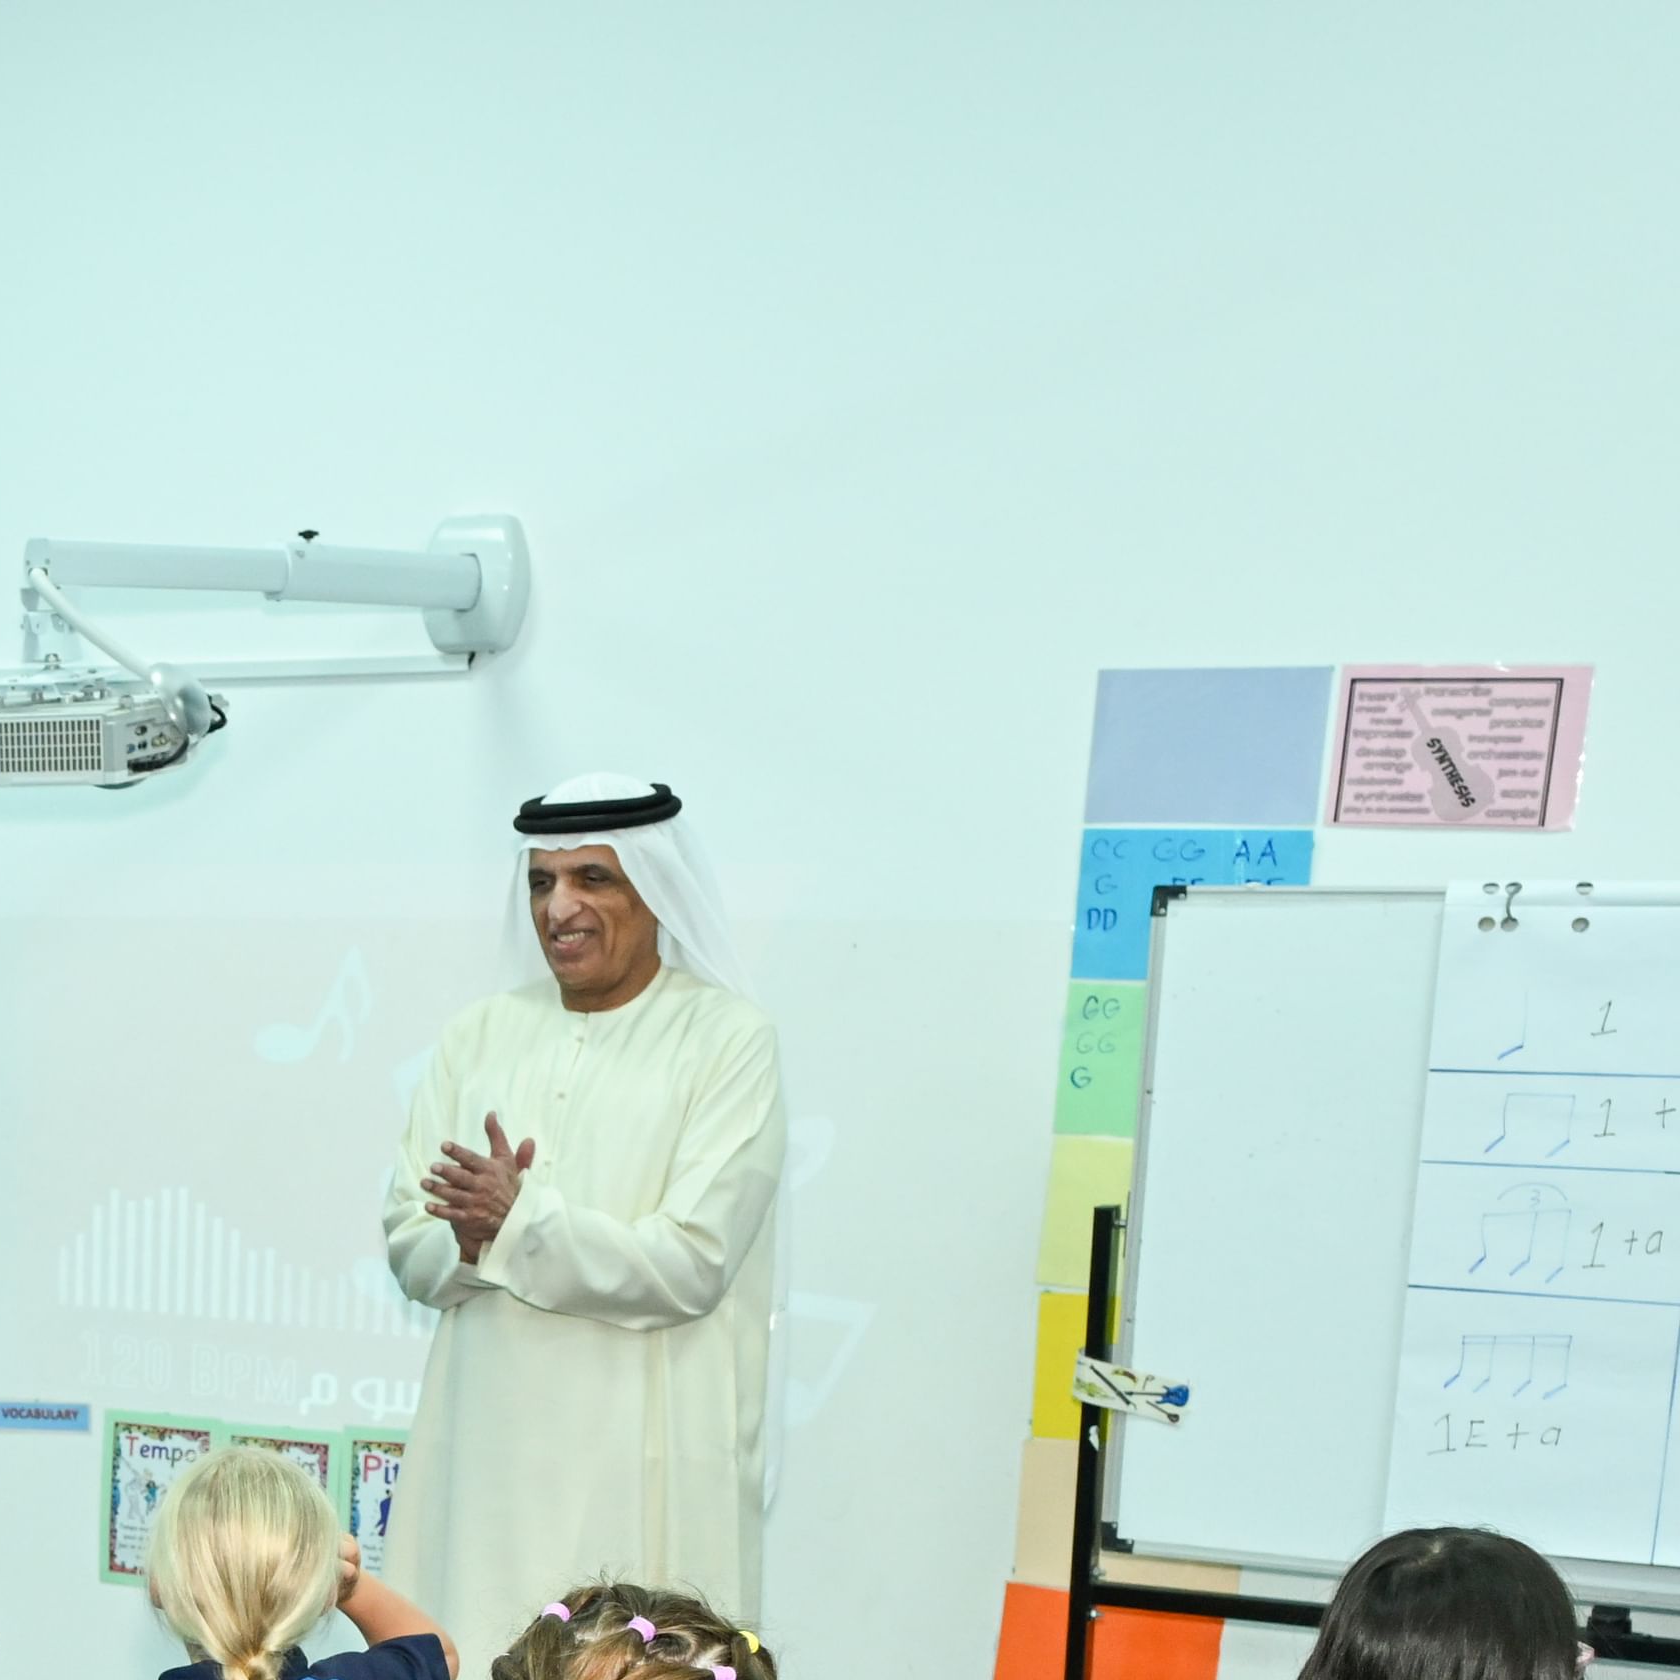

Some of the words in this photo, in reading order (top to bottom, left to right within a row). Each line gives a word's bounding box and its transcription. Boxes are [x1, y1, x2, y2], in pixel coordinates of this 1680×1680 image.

[1488, 698, 1552, 709] compose
[1355, 747, 1406, 759] develop
[1426, 737, 1476, 808] SYNTHESIS
[1233, 837, 1278, 867] AA
[1087, 907, 1118, 932] DD
[1590, 999, 1618, 1038] 1
[1593, 1097, 1617, 1138] 1
[1582, 1221, 1606, 1269] 1
[190, 1342, 299, 1405] BPM
[2, 1407, 79, 1421] VOCABULARY
[125, 1435, 198, 1467] Tempo
[362, 1454, 400, 1486] Pit
